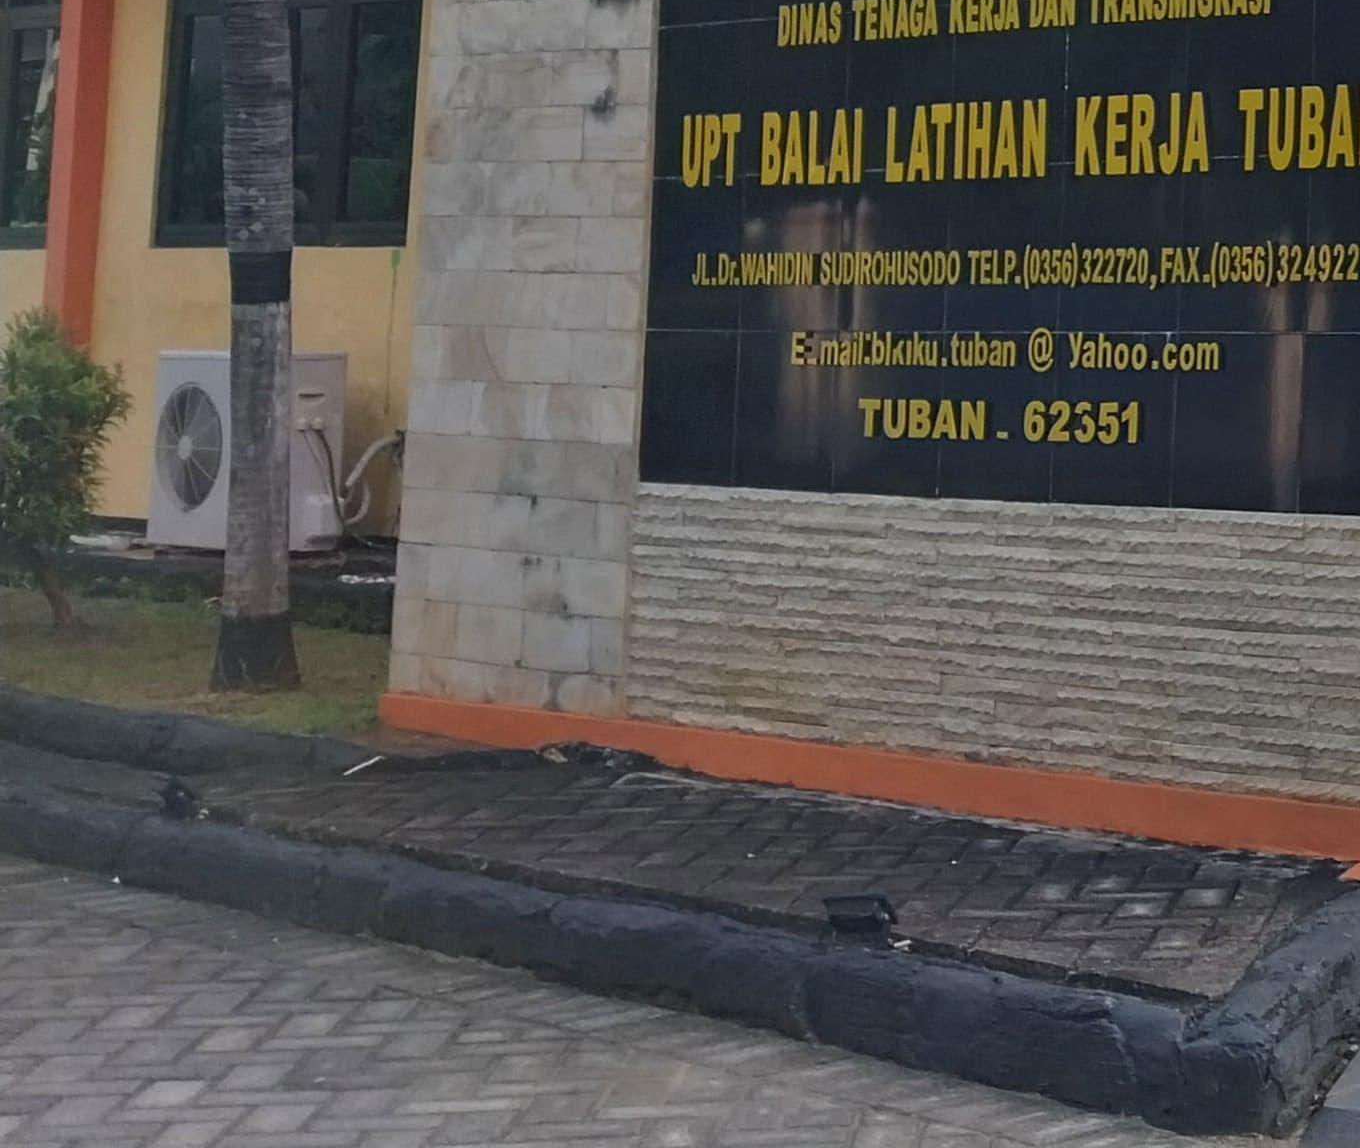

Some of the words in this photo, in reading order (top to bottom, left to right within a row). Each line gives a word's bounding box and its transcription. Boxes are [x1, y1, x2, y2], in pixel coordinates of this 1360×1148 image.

[777, 1, 842, 47] DINAS
[682, 113, 742, 188] UPT
[760, 107, 863, 186] BALAI
[885, 98, 1047, 183] LATIHAN
[1074, 91, 1209, 176] KERJA
[819, 250, 962, 286] SUDIROHUSODO
[1028, 327, 1054, 372] @
[1068, 332, 1220, 371] Yahoo.com
[858, 398, 986, 440] TUBAN
[1023, 400, 1139, 444] 62351
